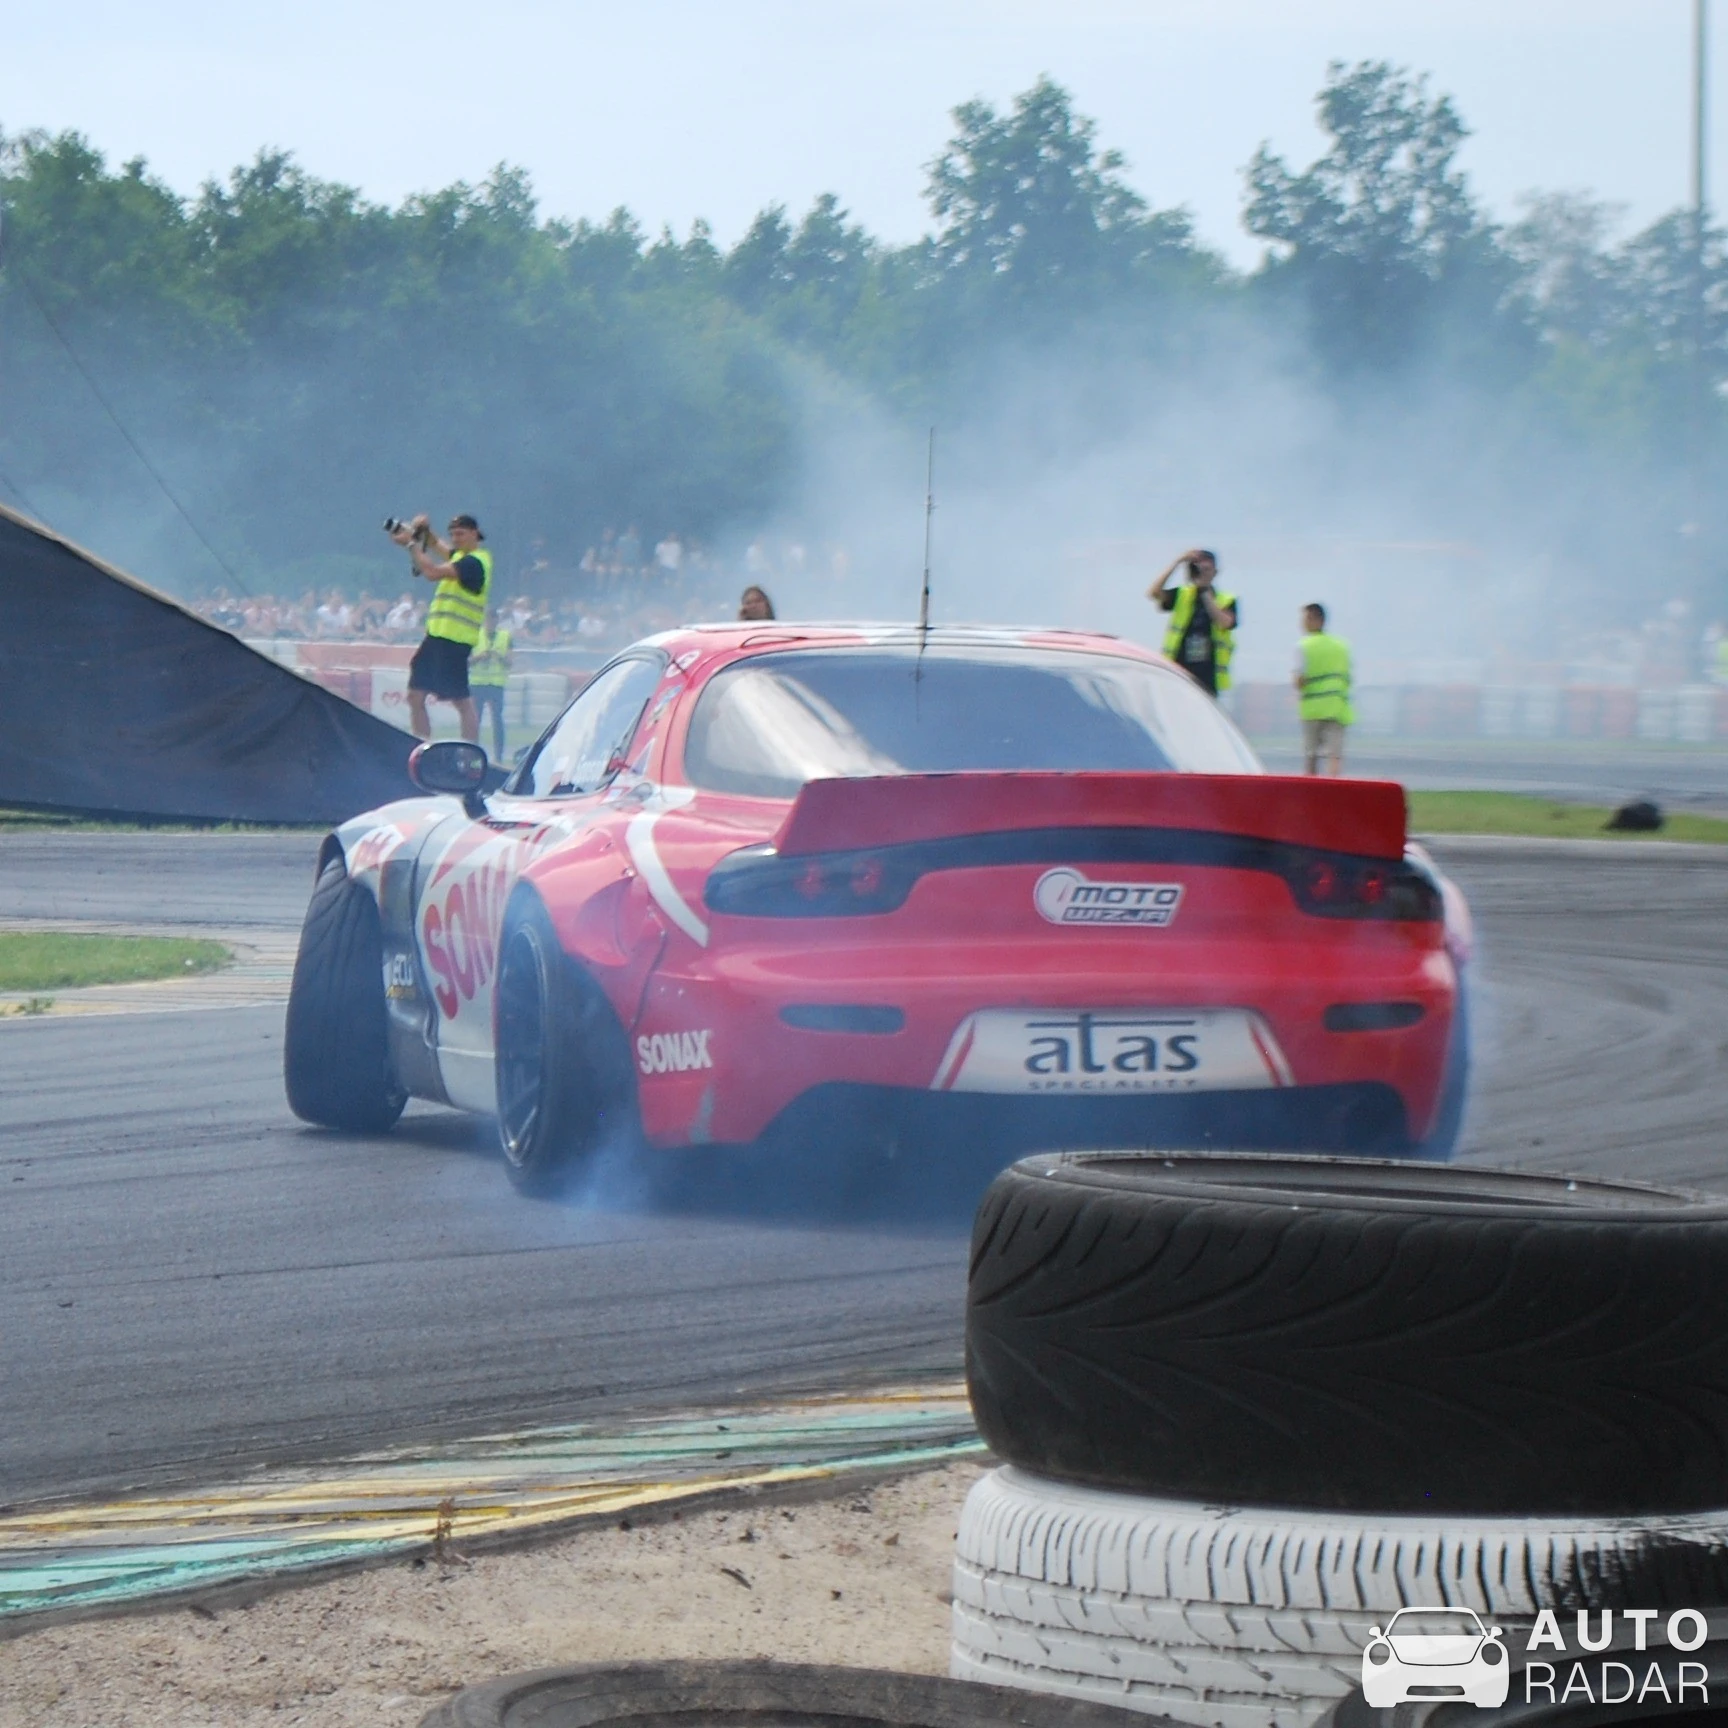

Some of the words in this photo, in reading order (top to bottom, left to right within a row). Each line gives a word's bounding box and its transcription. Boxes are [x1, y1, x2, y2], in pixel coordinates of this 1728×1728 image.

[1070, 886, 1178, 905] MOTO
[1062, 908, 1169, 922] WIZJA
[637, 1029, 713, 1075] SONAX
[1024, 1014, 1199, 1074] atas
[1028, 1079, 1198, 1090] SPECIALITY
